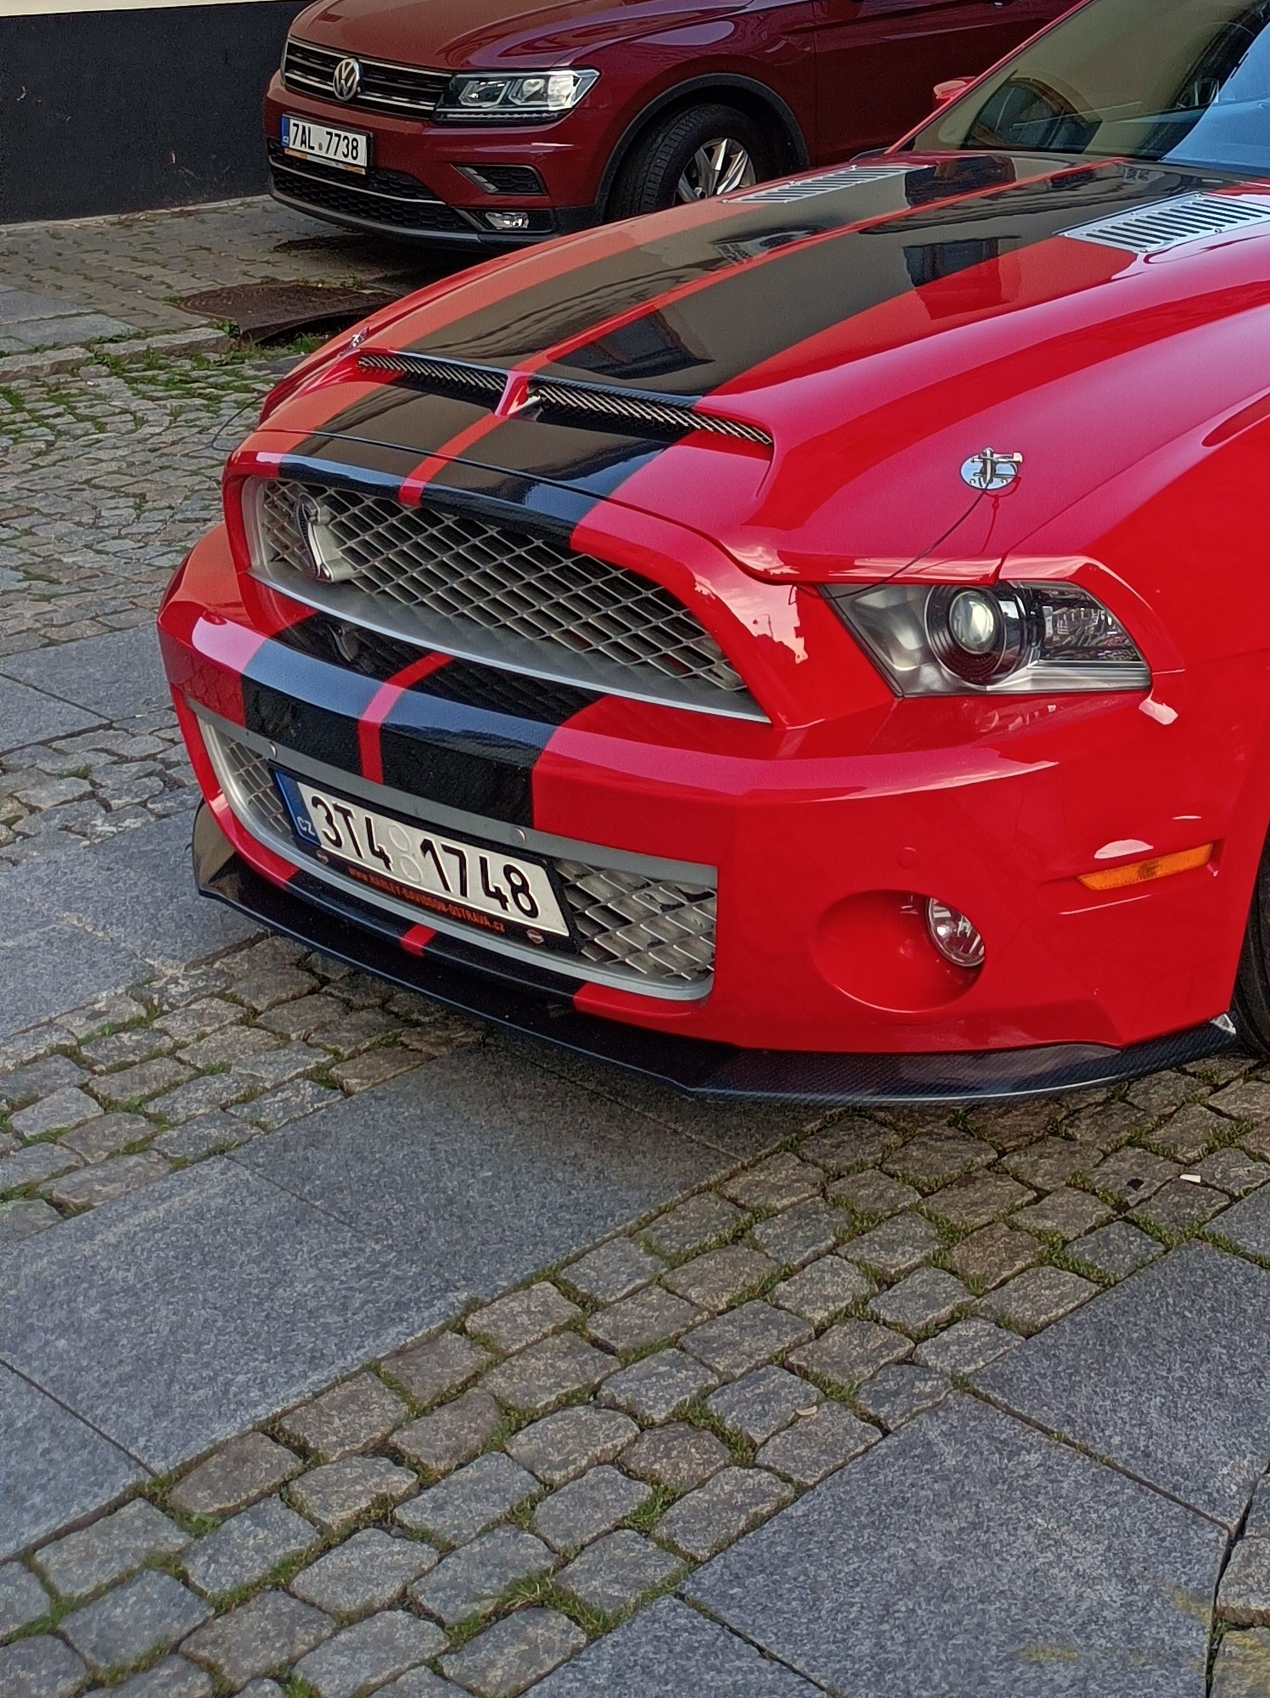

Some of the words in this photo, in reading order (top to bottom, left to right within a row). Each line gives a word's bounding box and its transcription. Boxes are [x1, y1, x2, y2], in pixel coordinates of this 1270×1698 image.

[292, 122, 316, 151] 7AL
[325, 130, 359, 161] 7738
[297, 815, 317, 837] CZ
[311, 795, 393, 873] 3T4
[420, 837, 541, 920] 1748
